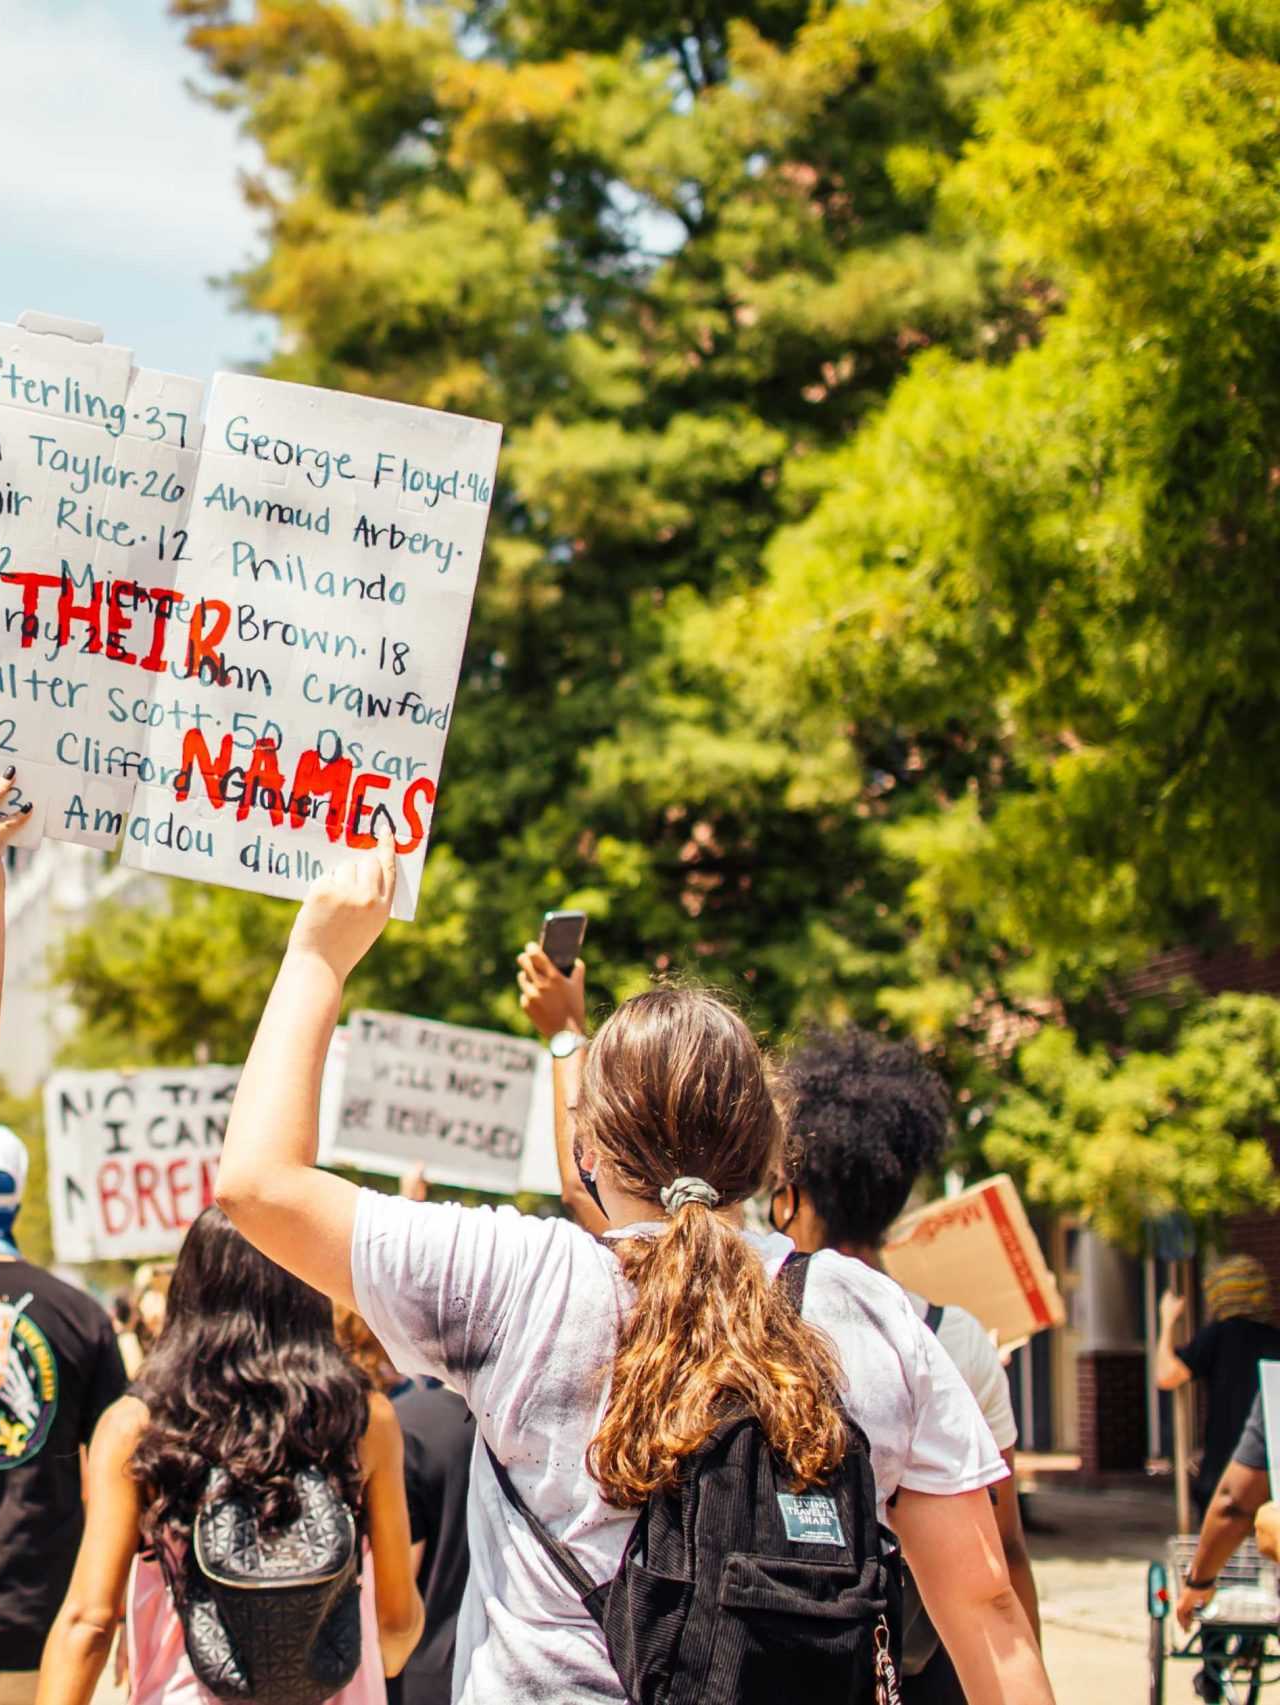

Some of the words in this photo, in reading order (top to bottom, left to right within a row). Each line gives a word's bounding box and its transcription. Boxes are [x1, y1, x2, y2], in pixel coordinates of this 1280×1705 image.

[225, 415, 355, 488] George
[204, 482, 330, 536] Ahmaud
[60, 559, 206, 627] Michael
[232, 541, 407, 605] Philando
[0, 572, 232, 686] THEIR
[172, 639, 272, 696] John
[303, 673, 450, 731] Crawford
[57, 732, 192, 794] Clifford
[317, 729, 428, 781] Oscar
[176, 728, 437, 854] NAMES
[64, 795, 214, 858] Amadou
[447, 1069, 509, 1101] NOT
[104, 1120, 131, 1154] I
[794, 1500, 830, 1509] LIVING
